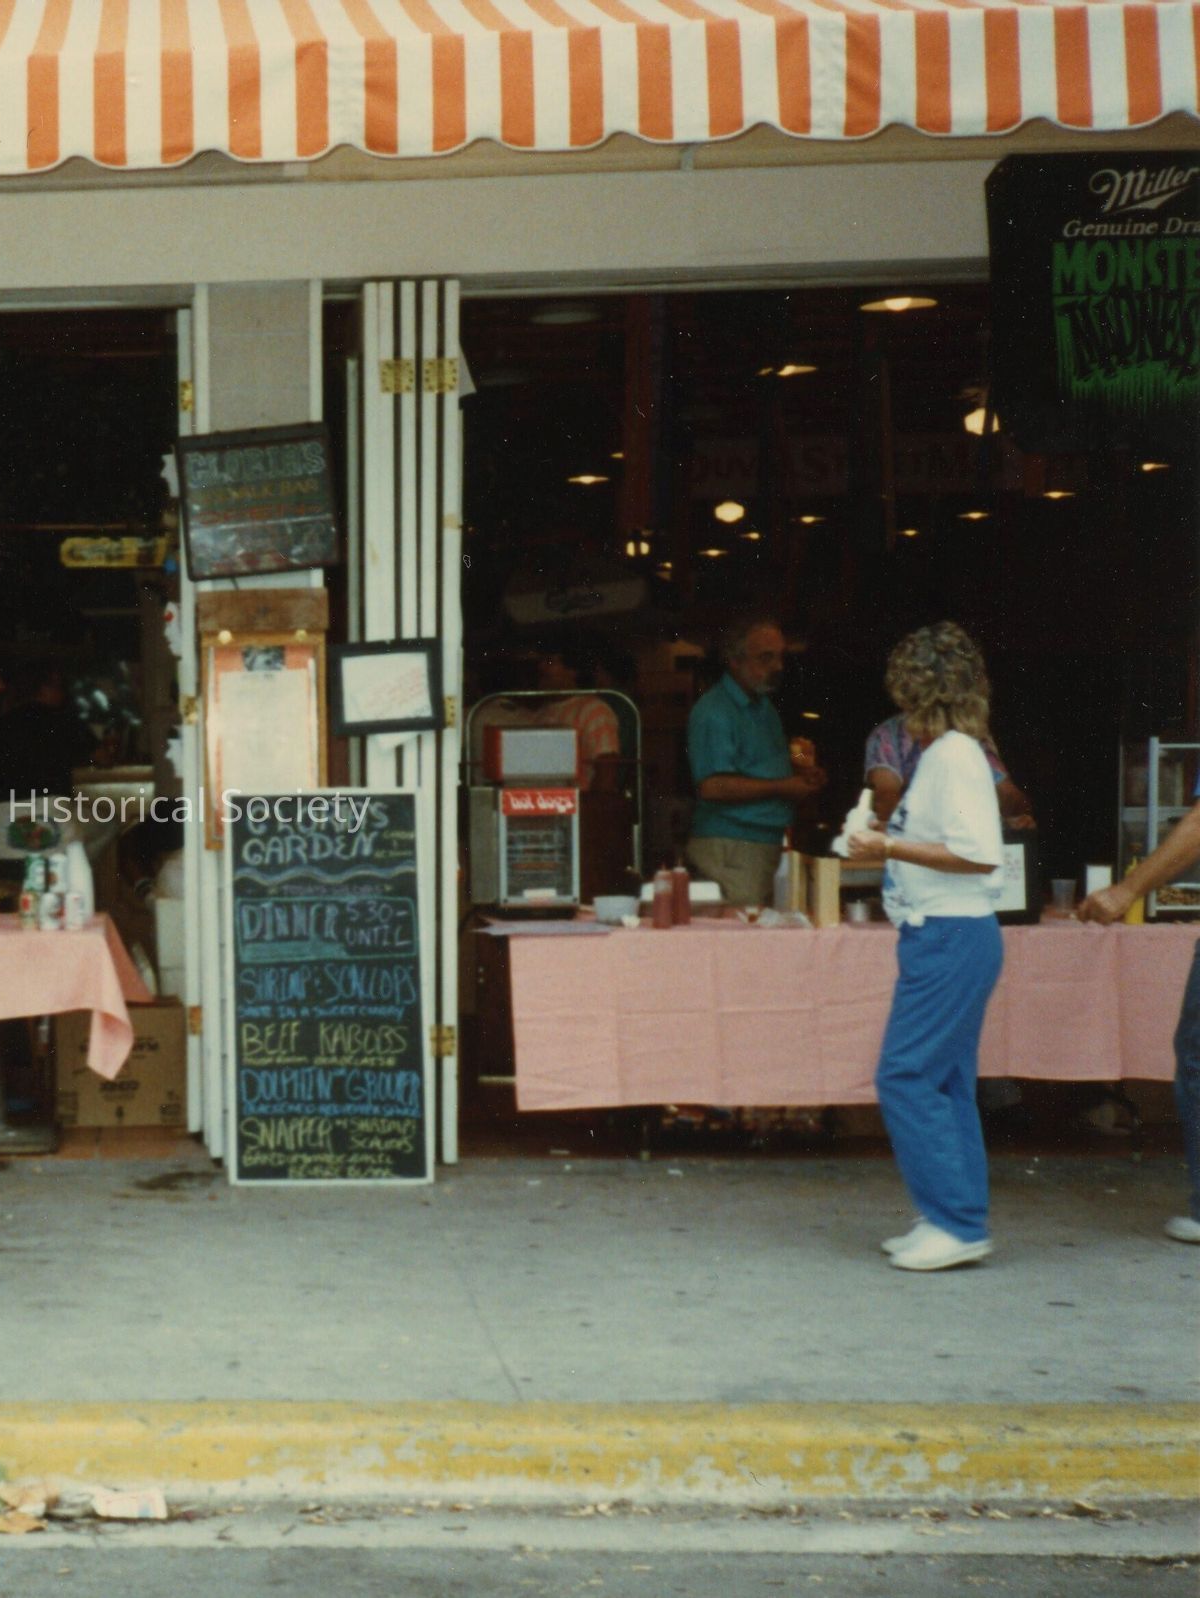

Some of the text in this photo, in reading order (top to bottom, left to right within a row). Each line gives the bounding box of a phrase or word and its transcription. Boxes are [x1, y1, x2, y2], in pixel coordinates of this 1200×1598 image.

[1089, 166, 1200, 214] Miller
[1062, 219, 1160, 238] Genuine
[506, 791, 575, 814] hot dogs
[242, 831, 378, 866] GARDEN
[241, 1021, 301, 1056] BEEF
